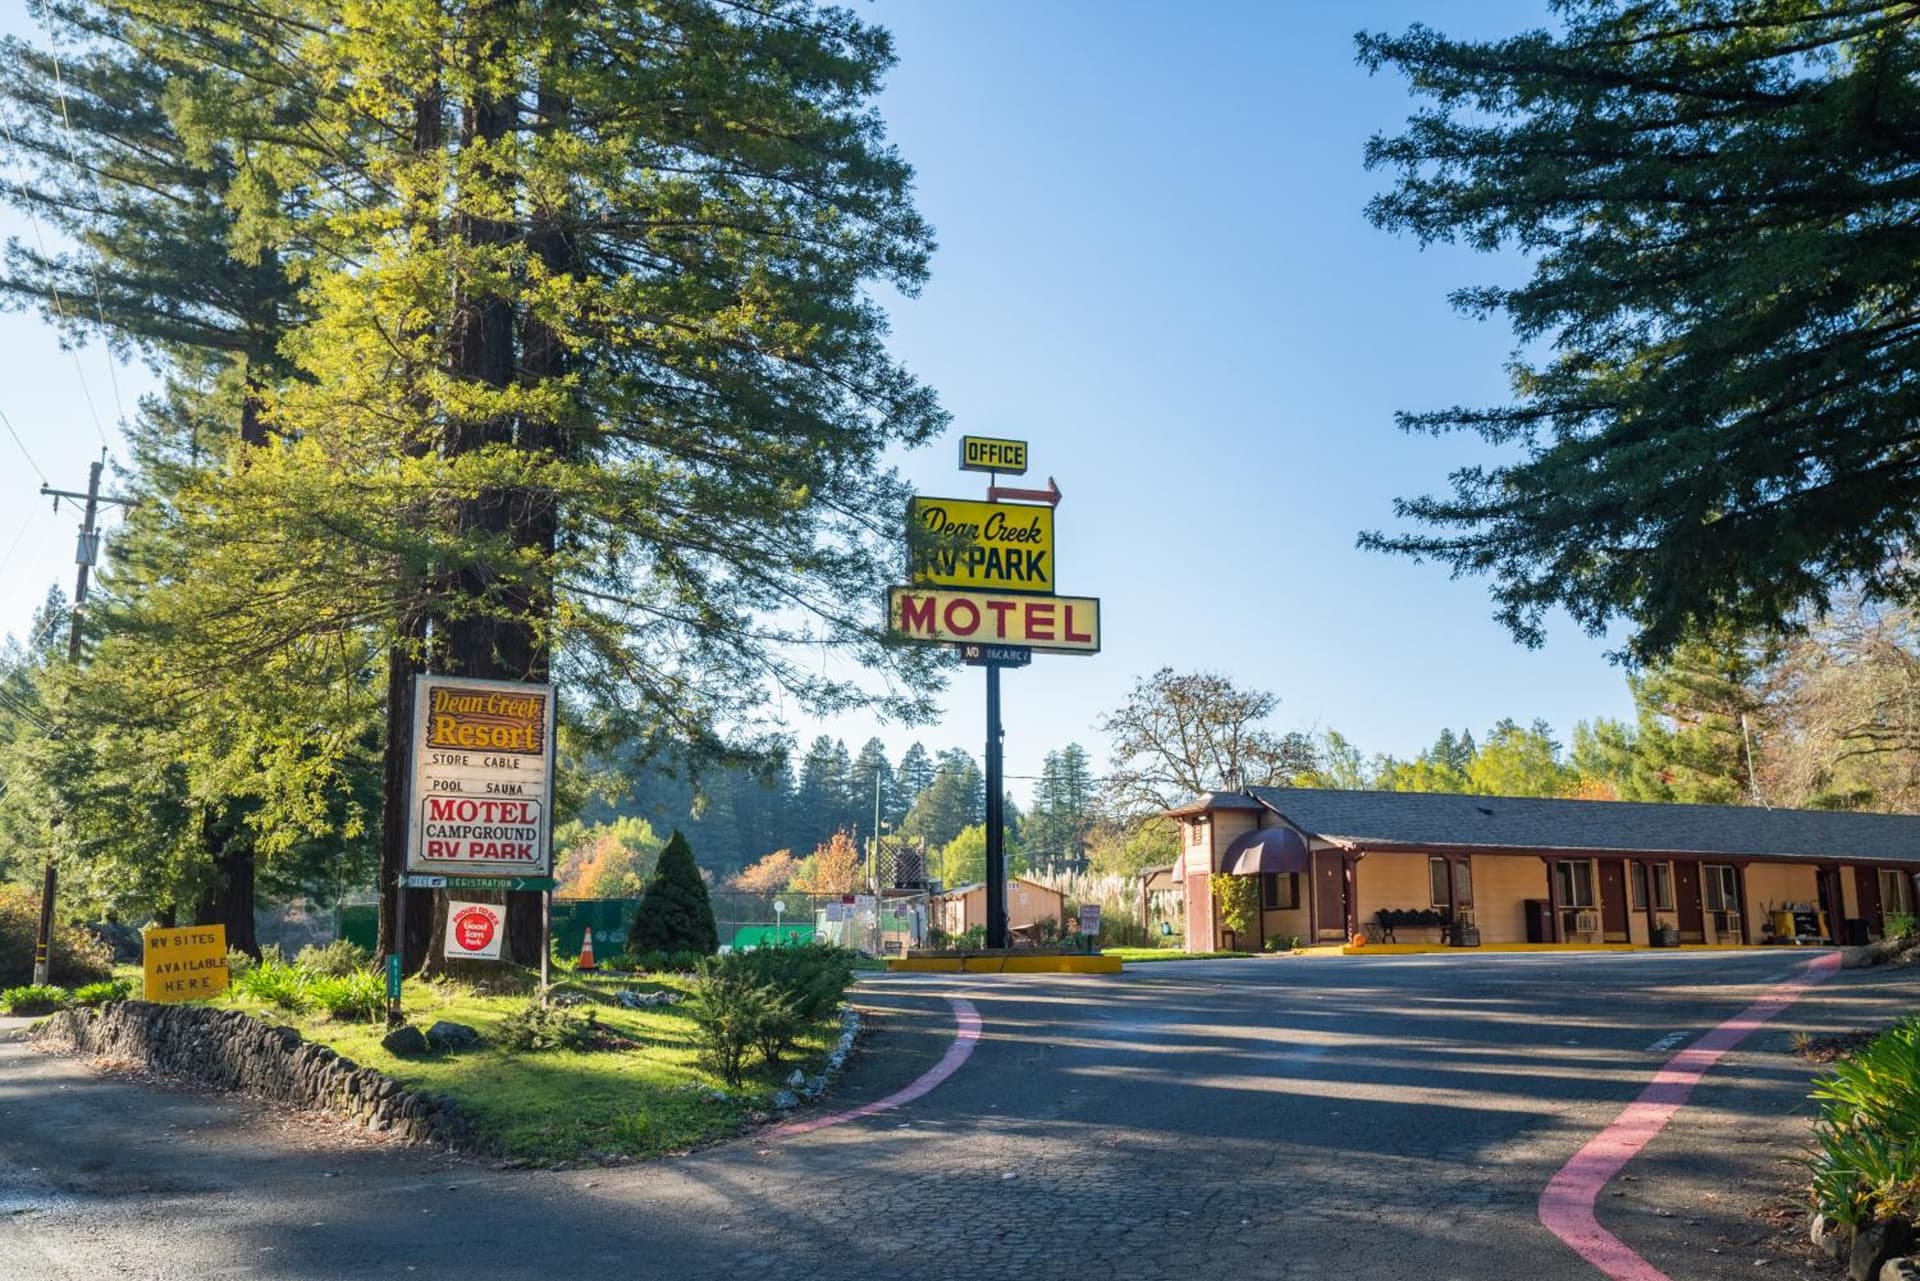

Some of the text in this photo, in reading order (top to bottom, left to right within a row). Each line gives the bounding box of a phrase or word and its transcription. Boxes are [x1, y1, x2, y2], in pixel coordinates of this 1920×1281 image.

[968, 441, 1023, 465] OFFICE
[984, 511, 1042, 544] Creek
[968, 546, 1048, 583] PARK
[901, 594, 1092, 643] MOTEL
[965, 646, 979, 658] NO
[433, 690, 539, 719] Dean Creek
[433, 715, 537, 750] Resort
[432, 754, 520, 769] STORE CABLE
[433, 780, 523, 795] POOL SAUNA
[429, 799, 538, 825] MOTEL
[426, 823, 537, 842] CAMPGROUND
[427, 842, 534, 860] RV PARK
[151, 934, 216, 949] RV SITES
[156, 958, 227, 974] AVAILABLE
[164, 977, 211, 992] HERE
